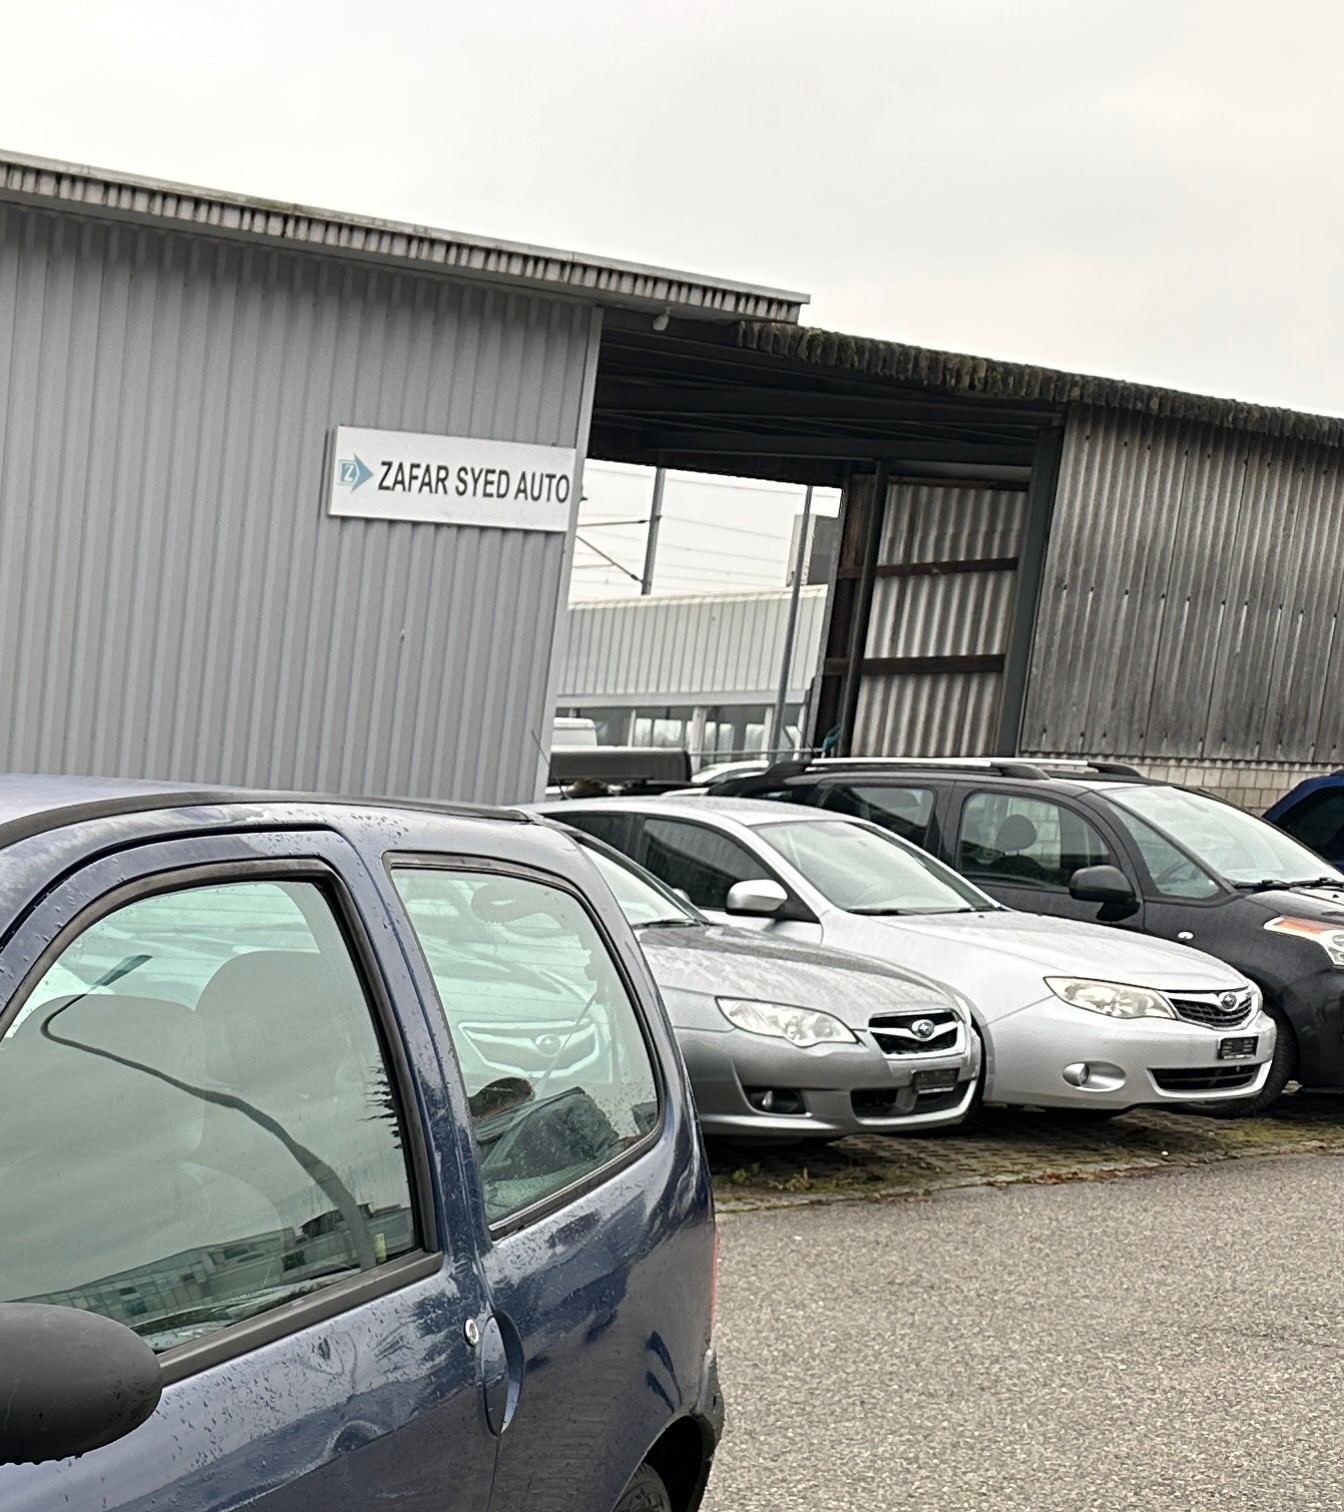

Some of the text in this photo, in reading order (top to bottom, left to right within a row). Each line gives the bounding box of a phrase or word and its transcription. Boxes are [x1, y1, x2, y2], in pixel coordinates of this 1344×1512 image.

[378, 460, 449, 494] ZAFAR
[455, 465, 510, 498] SYED
[514, 471, 570, 503] AUTO
